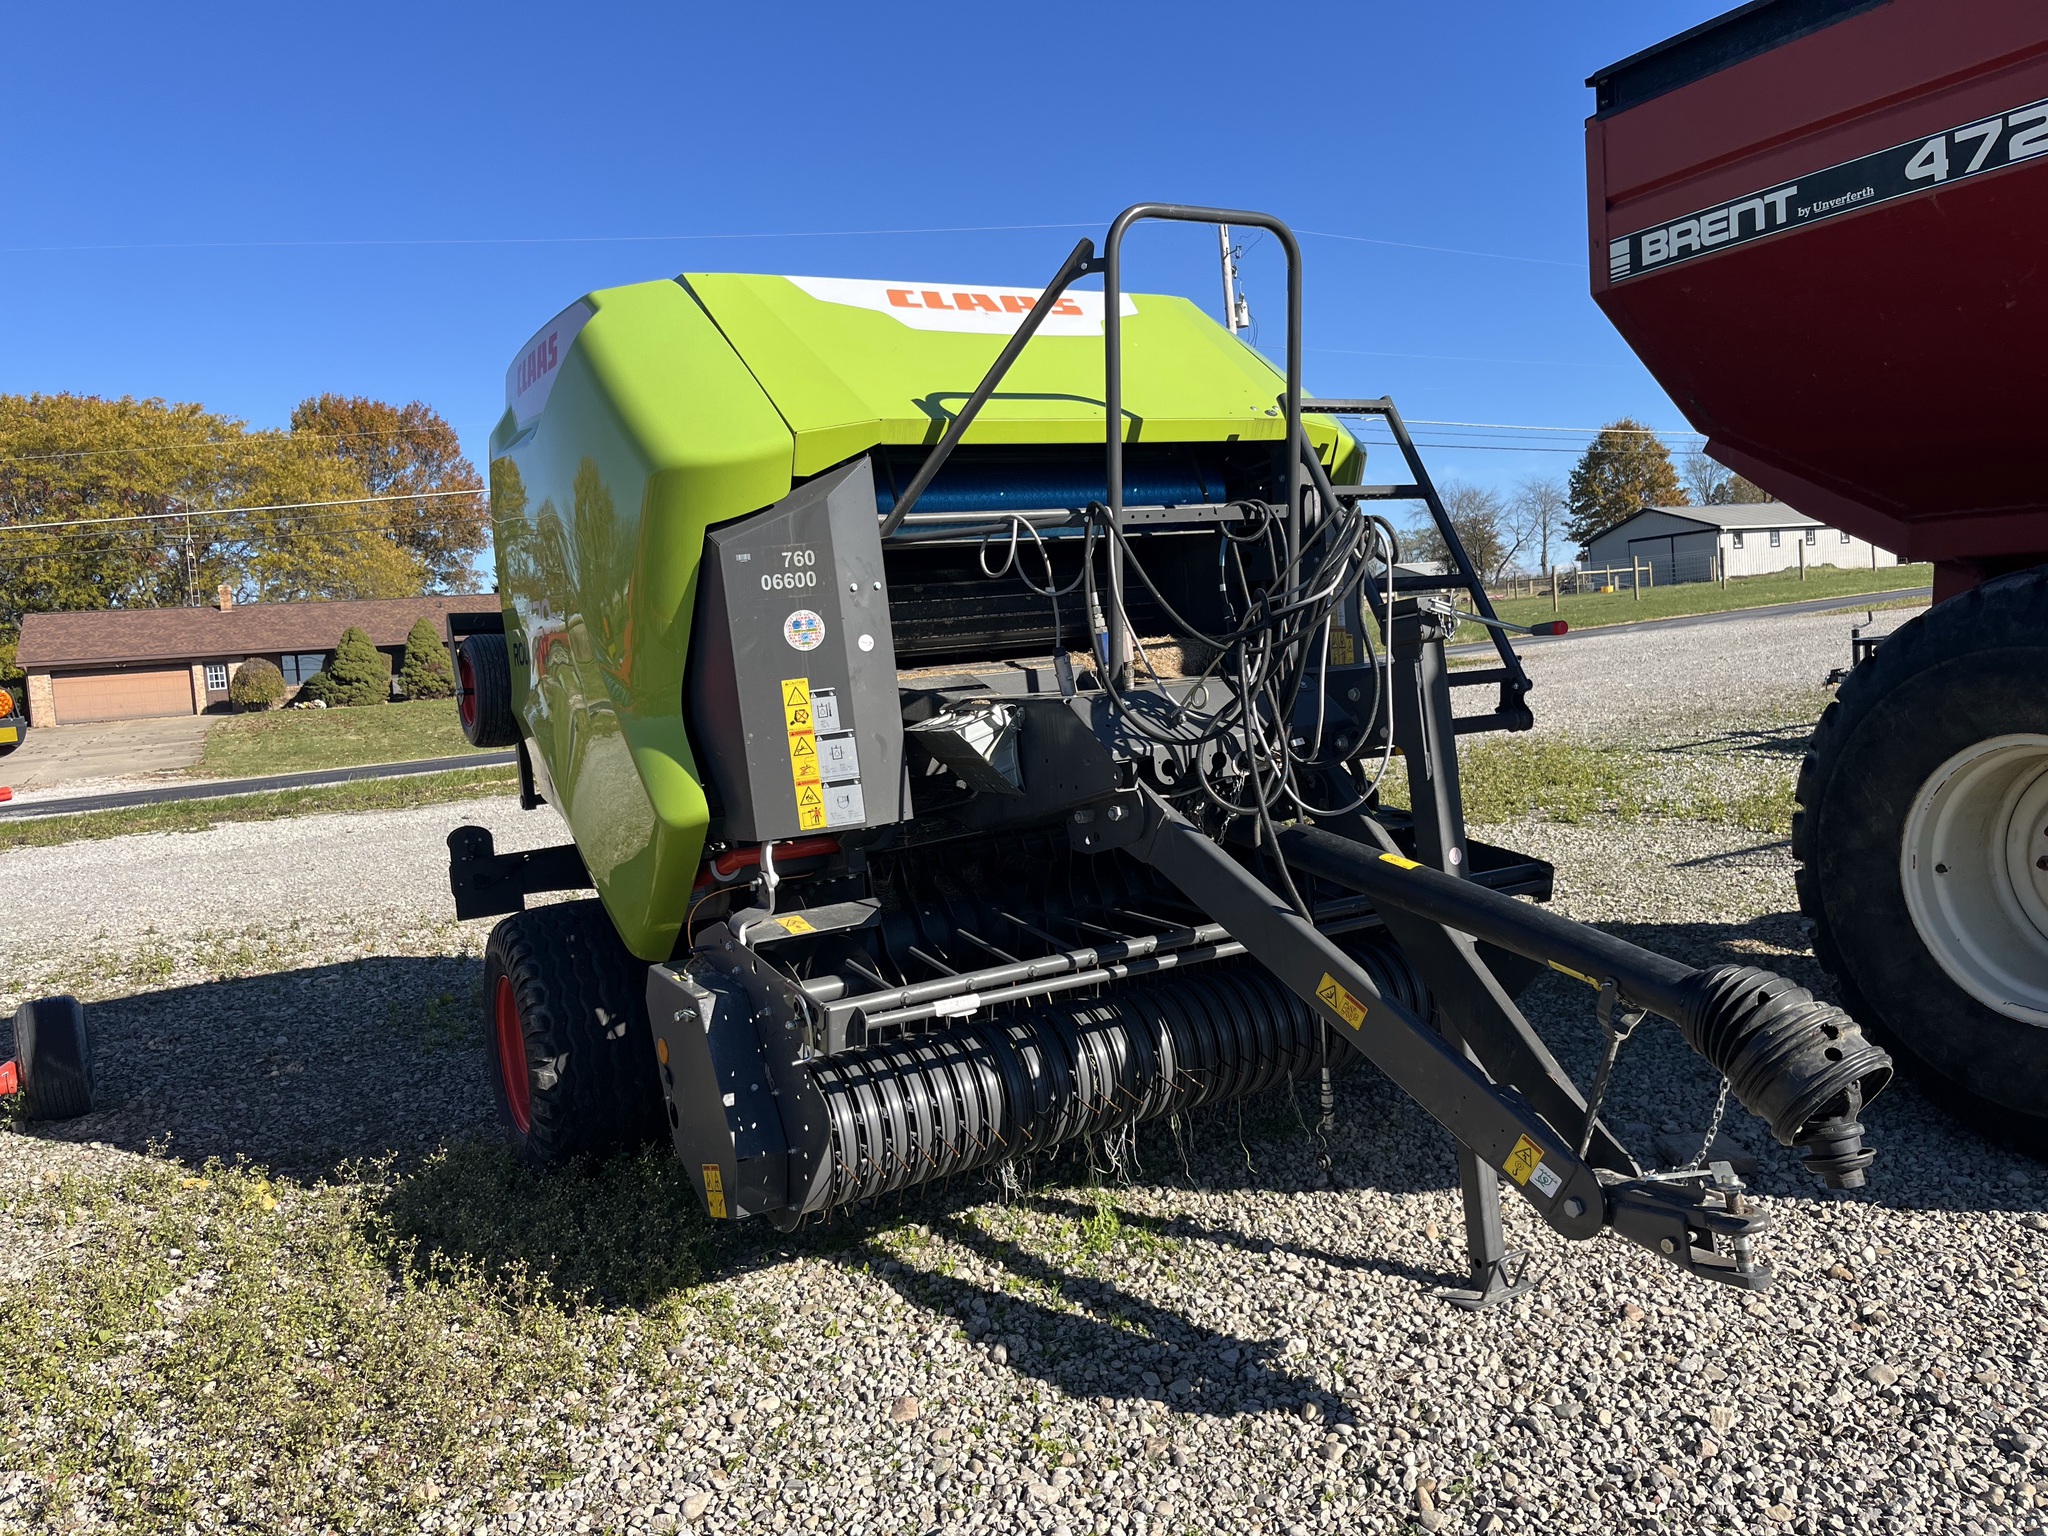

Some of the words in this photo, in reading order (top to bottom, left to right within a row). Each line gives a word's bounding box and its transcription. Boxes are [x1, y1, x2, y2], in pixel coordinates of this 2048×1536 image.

[1641, 185, 1798, 267] BRENT
[1797, 206, 1812, 218] by
[1812, 186, 1875, 214] Unverferth
[1904, 103, 2048, 182] 472
[886, 288, 1083, 316] CLAAS
[517, 331, 558, 399] CLAAS
[781, 550, 816, 568] 760
[760, 571, 817, 591] 06600
